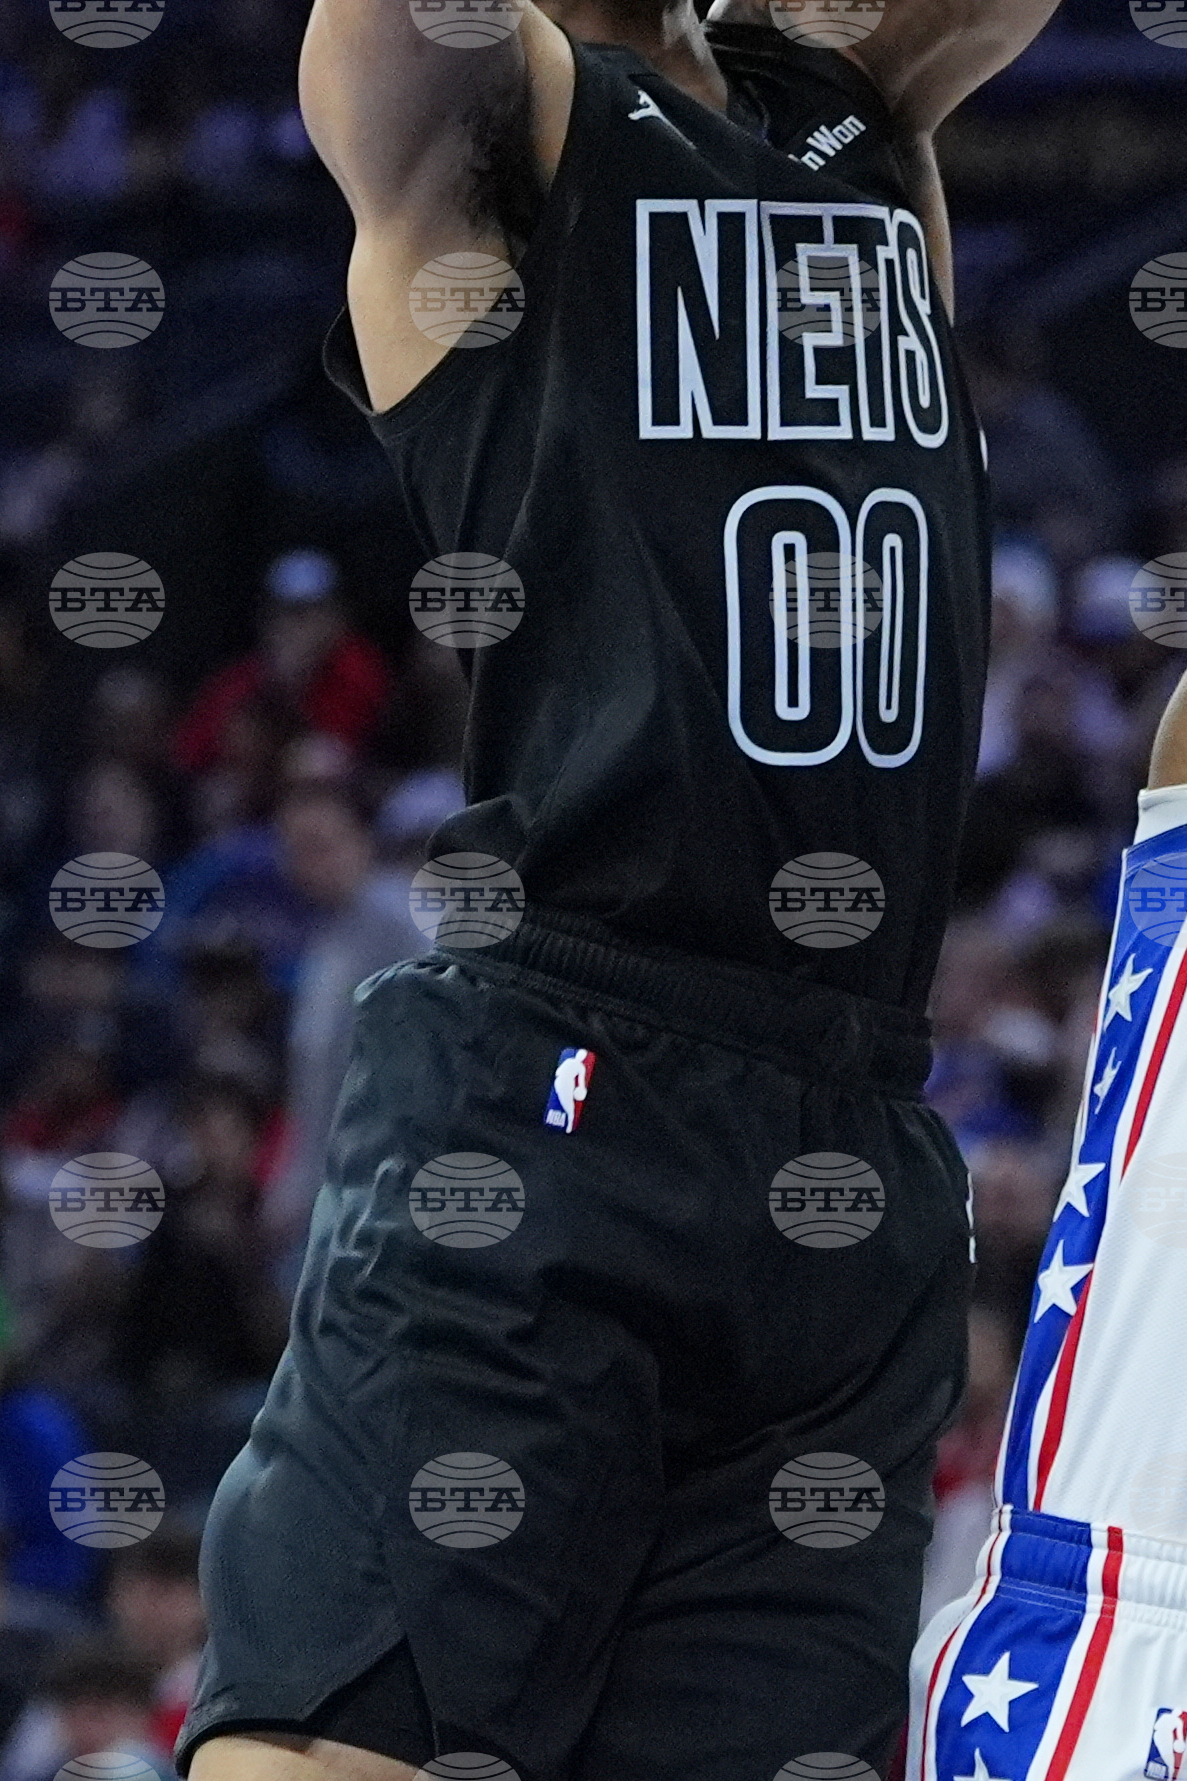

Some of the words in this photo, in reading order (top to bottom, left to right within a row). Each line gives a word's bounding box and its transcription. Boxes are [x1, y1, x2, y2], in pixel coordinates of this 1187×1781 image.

[806, 114, 866, 157] Won
[636, 198, 949, 449] NETS
[723, 484, 929, 769] 00
